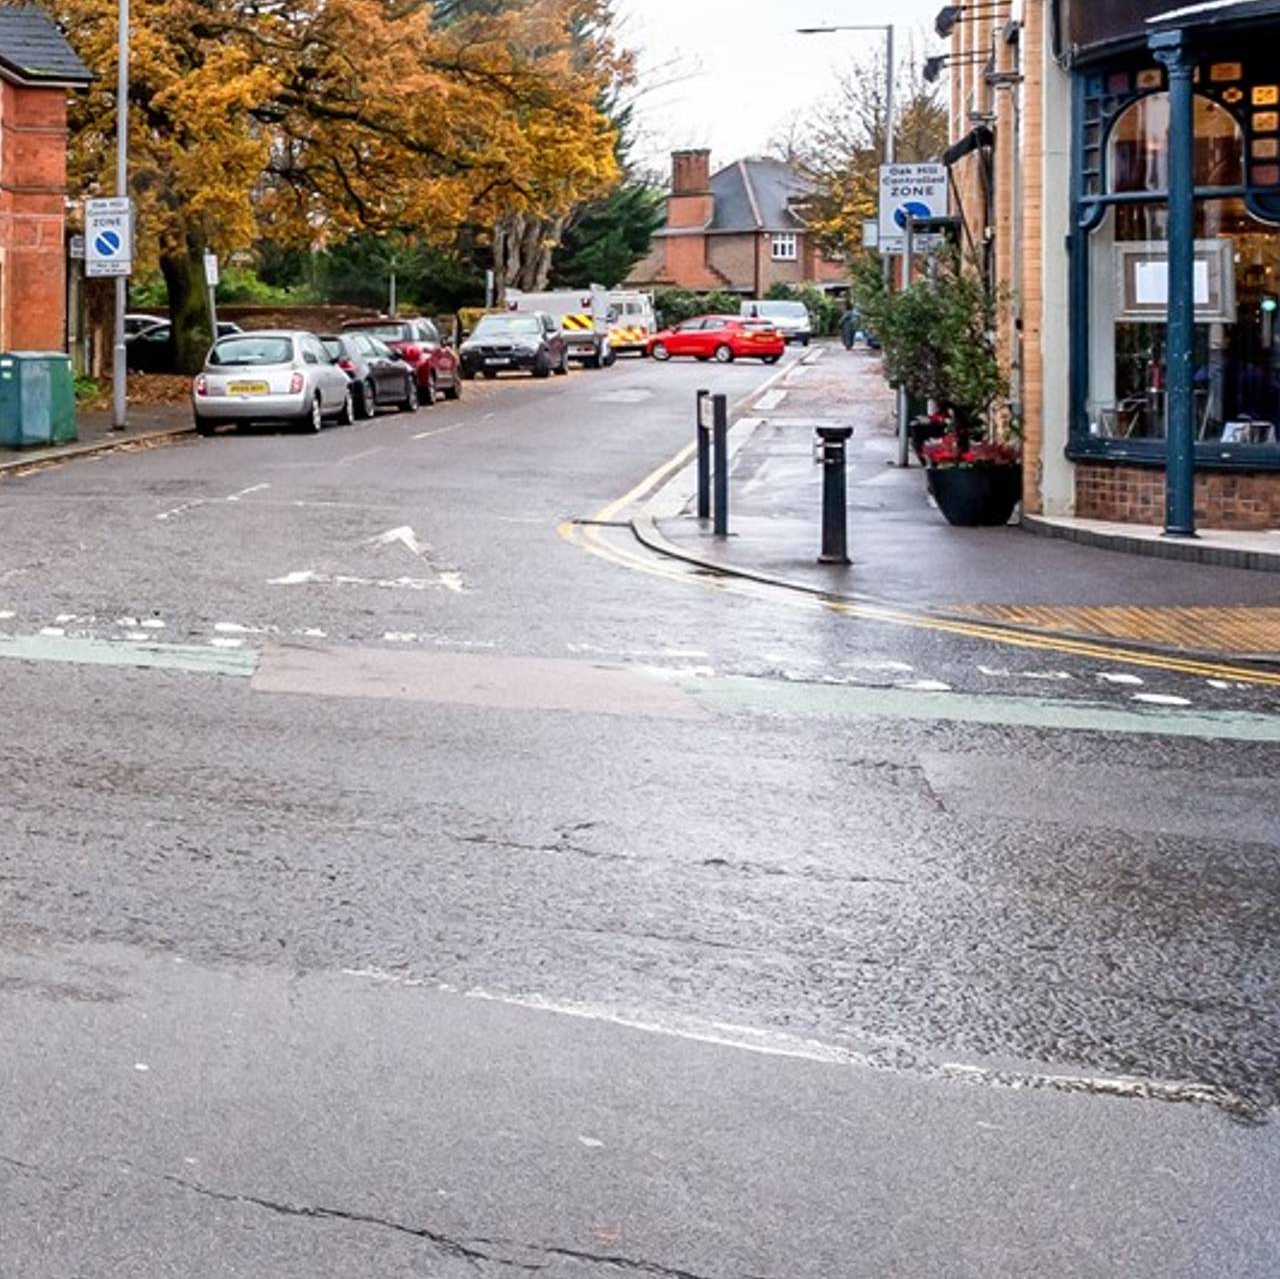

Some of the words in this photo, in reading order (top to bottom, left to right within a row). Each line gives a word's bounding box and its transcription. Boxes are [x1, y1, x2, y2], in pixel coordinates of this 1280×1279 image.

[889, 167, 911, 176] Oak
[917, 166, 938, 174] Hill
[882, 175, 945, 185] Controlled
[891, 186, 934, 197] ZONE
[93, 218, 120, 227] ZONE
